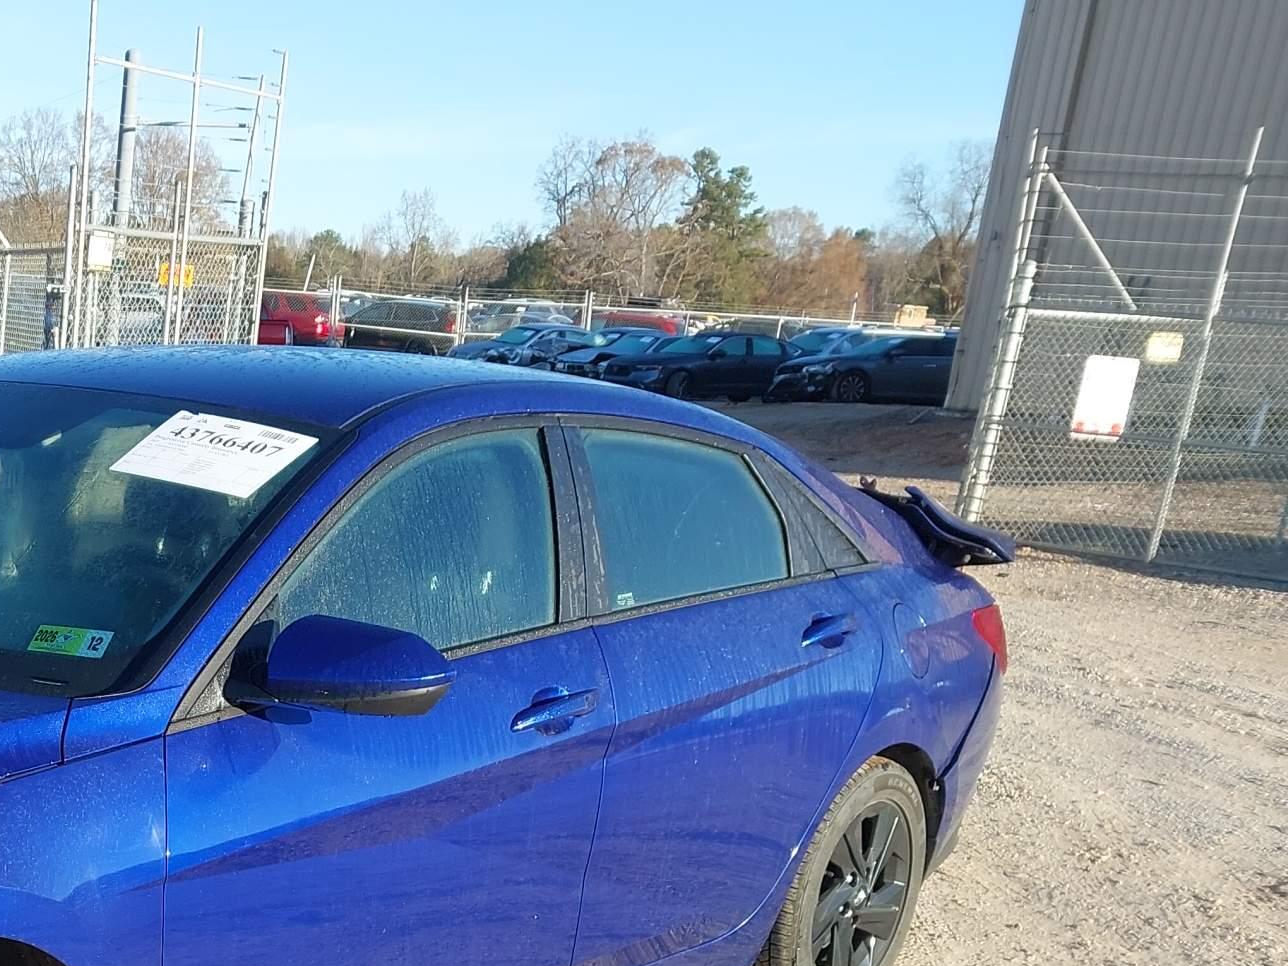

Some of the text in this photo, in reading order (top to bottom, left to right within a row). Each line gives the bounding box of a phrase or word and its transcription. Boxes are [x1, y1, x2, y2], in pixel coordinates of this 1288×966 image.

[169, 425, 285, 457] 43766407
[34, 629, 104, 651] 2026 12
